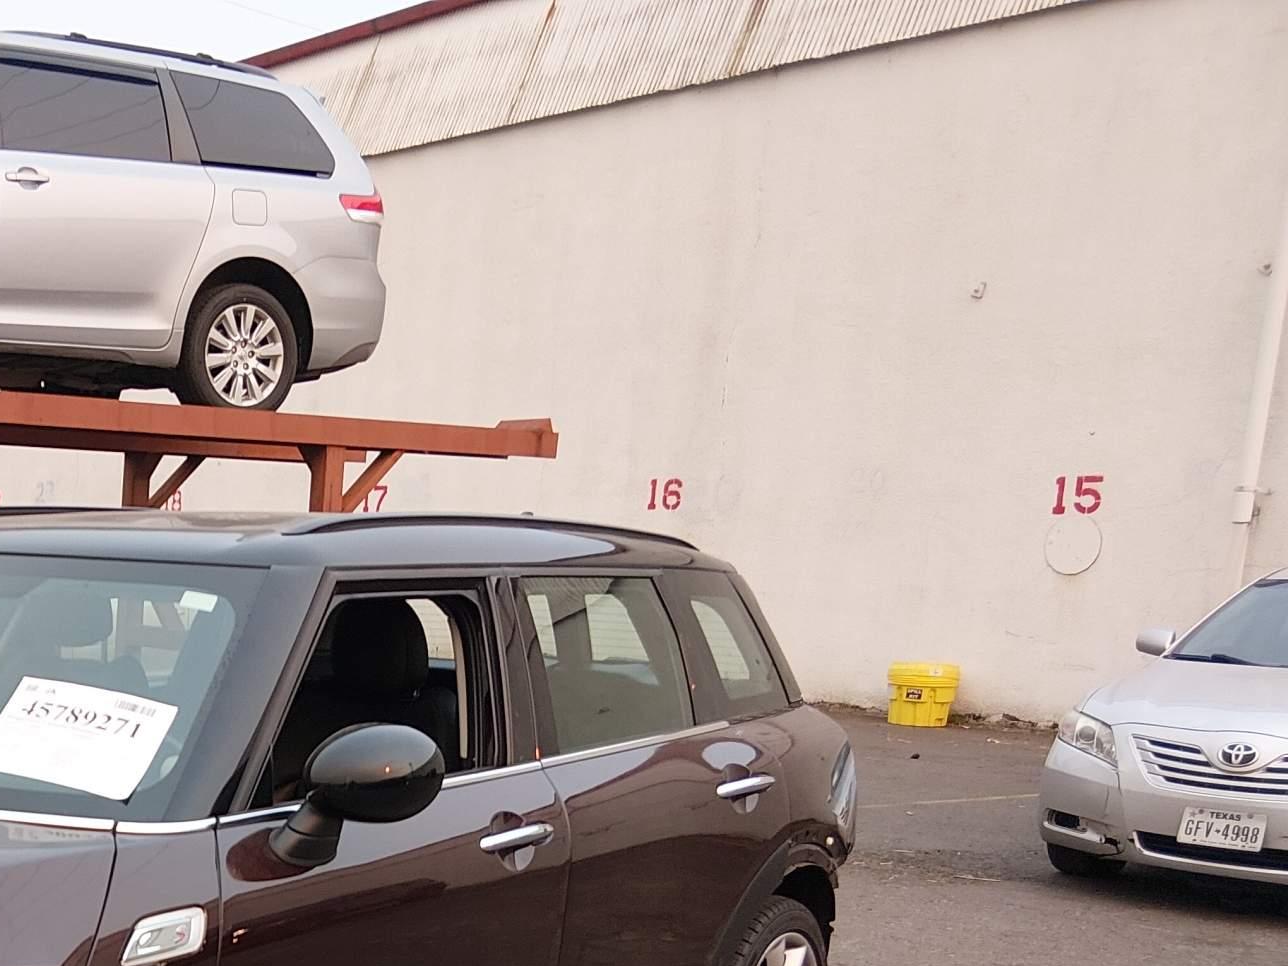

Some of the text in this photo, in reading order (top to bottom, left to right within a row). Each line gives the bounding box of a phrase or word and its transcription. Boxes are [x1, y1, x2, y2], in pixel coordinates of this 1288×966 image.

[647, 478, 683, 511] 16
[1051, 475, 1104, 515] 15
[21, 700, 142, 739] 45789271
[1209, 811, 1241, 821] TEXAS
